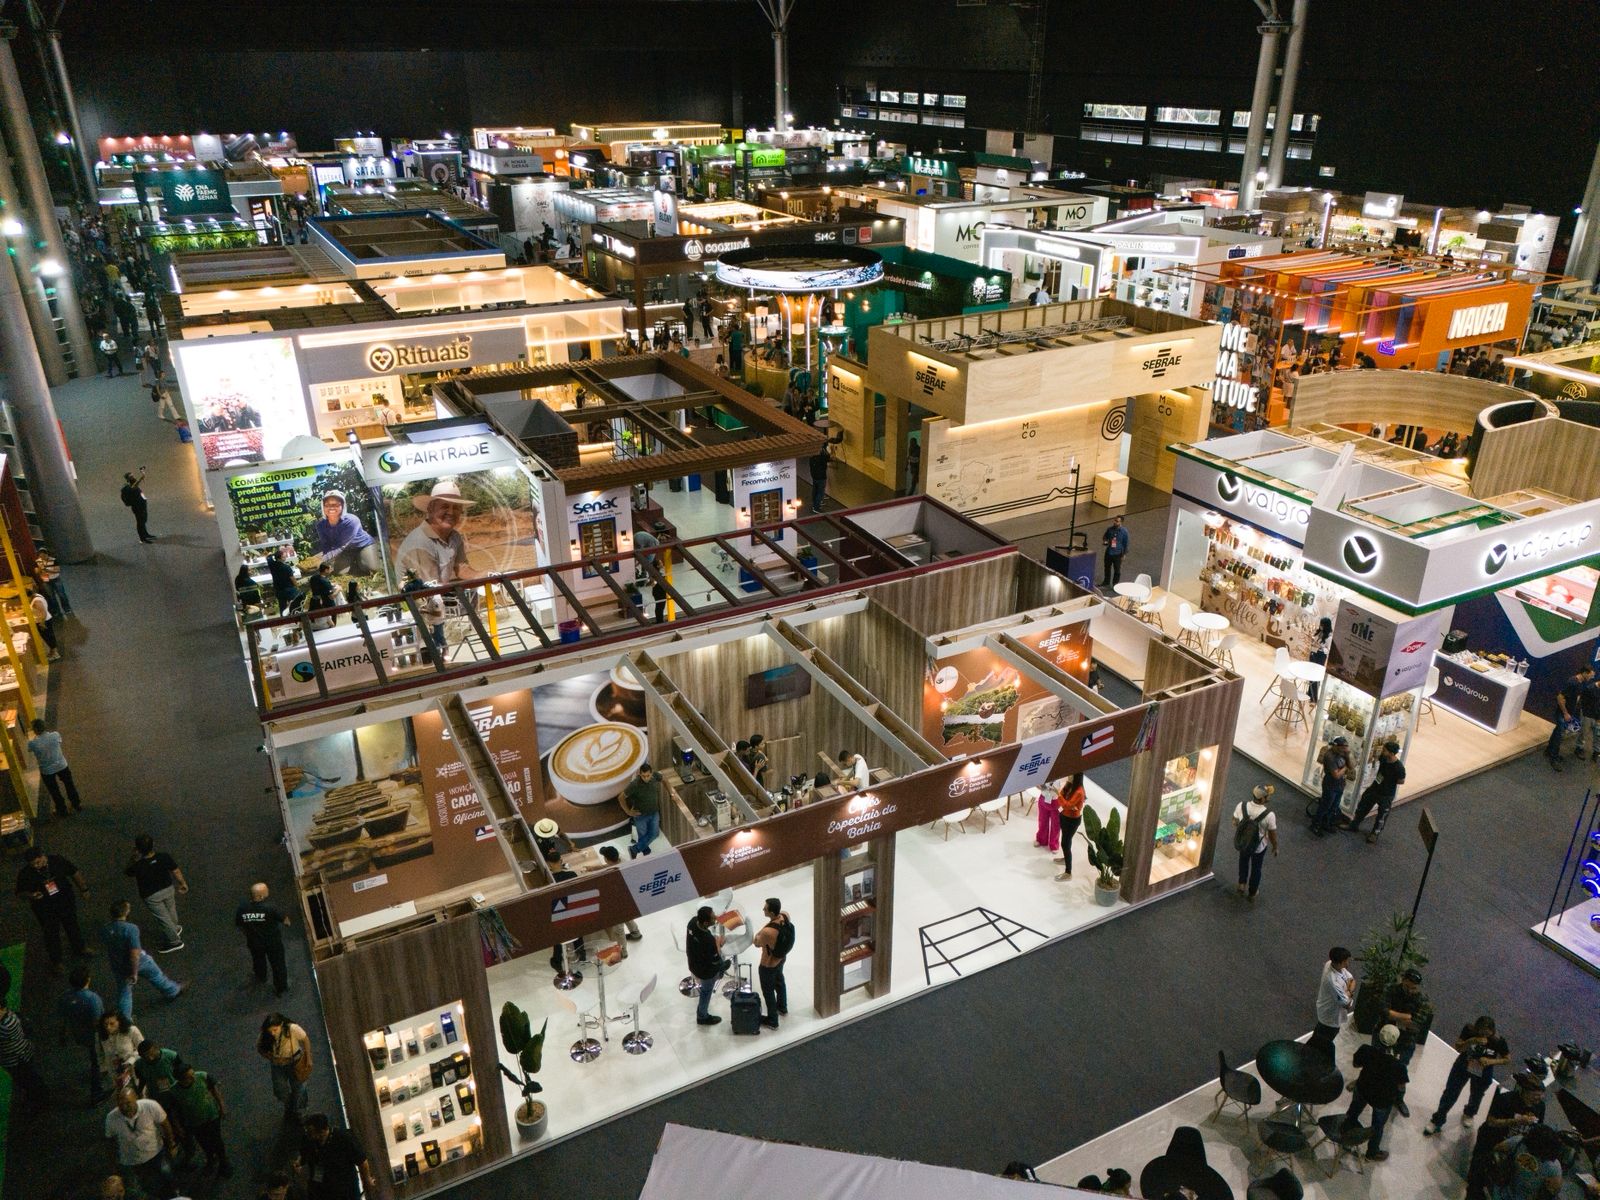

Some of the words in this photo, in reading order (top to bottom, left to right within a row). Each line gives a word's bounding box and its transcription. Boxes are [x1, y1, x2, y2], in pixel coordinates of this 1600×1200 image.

[814, 231, 836, 241] SMC
[1447, 303, 1509, 339] NAVEIA
[395, 340, 470, 366] Rituais
[1142, 355, 1182, 370] SEBRAE
[916, 371, 946, 391] SEBRAE
[405, 441, 490, 467] FAIRTRADE
[282, 470, 308, 482] JUSTO
[741, 475, 778, 487] Fecomércio
[779, 472, 790, 480] MG
[236, 485, 275, 497] produtos
[238, 496, 250, 505] de
[250, 491, 292, 505] qualidade
[240, 504, 260, 514] para
[267, 499, 291, 509] Brasil
[249, 512, 268, 522] para
[275, 507, 303, 517] Mundo
[1039, 633, 1072, 649] SEBRAE
[320, 648, 390, 672] FAIRTRAE
[1454, 681, 1489, 702] valgroup
[1019, 757, 1051, 772] SEBRAE
[828, 811, 881, 834] Especiais
[882, 804, 898, 816] da
[846, 821, 882, 839] Bahia
[639, 873, 682, 894] SEBRAE
[242, 912, 265, 920] STAFF
